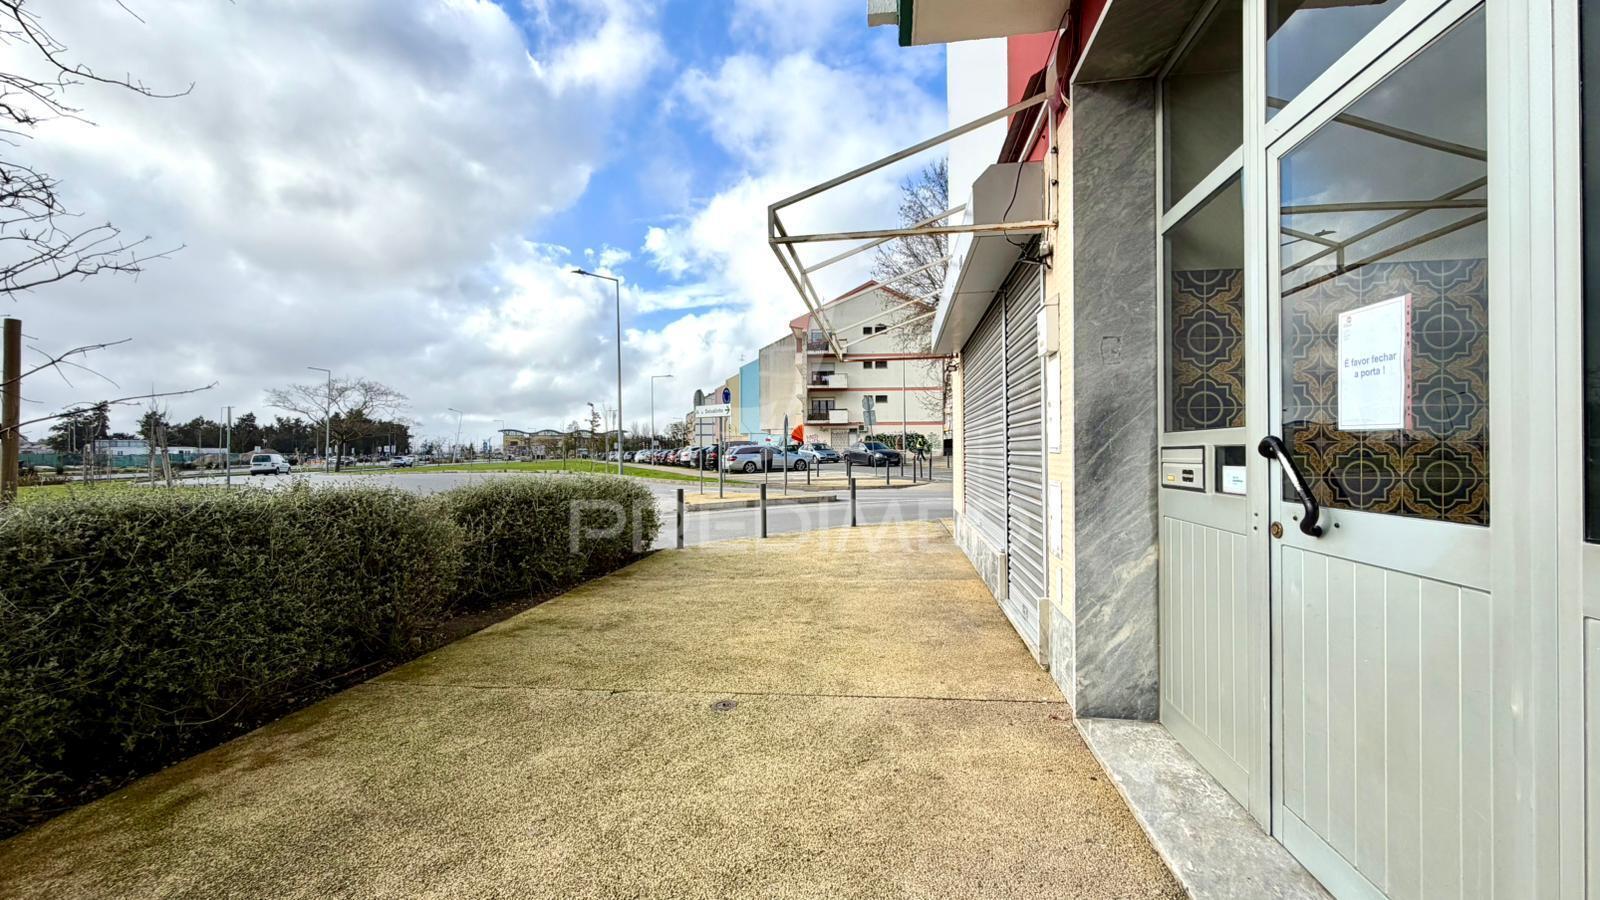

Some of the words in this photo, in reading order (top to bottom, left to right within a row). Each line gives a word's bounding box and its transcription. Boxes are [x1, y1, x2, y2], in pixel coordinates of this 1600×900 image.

[1351, 357, 1370, 367] favor
[1371, 352, 1397, 363] fechar
[1360, 368, 1381, 380] porta
